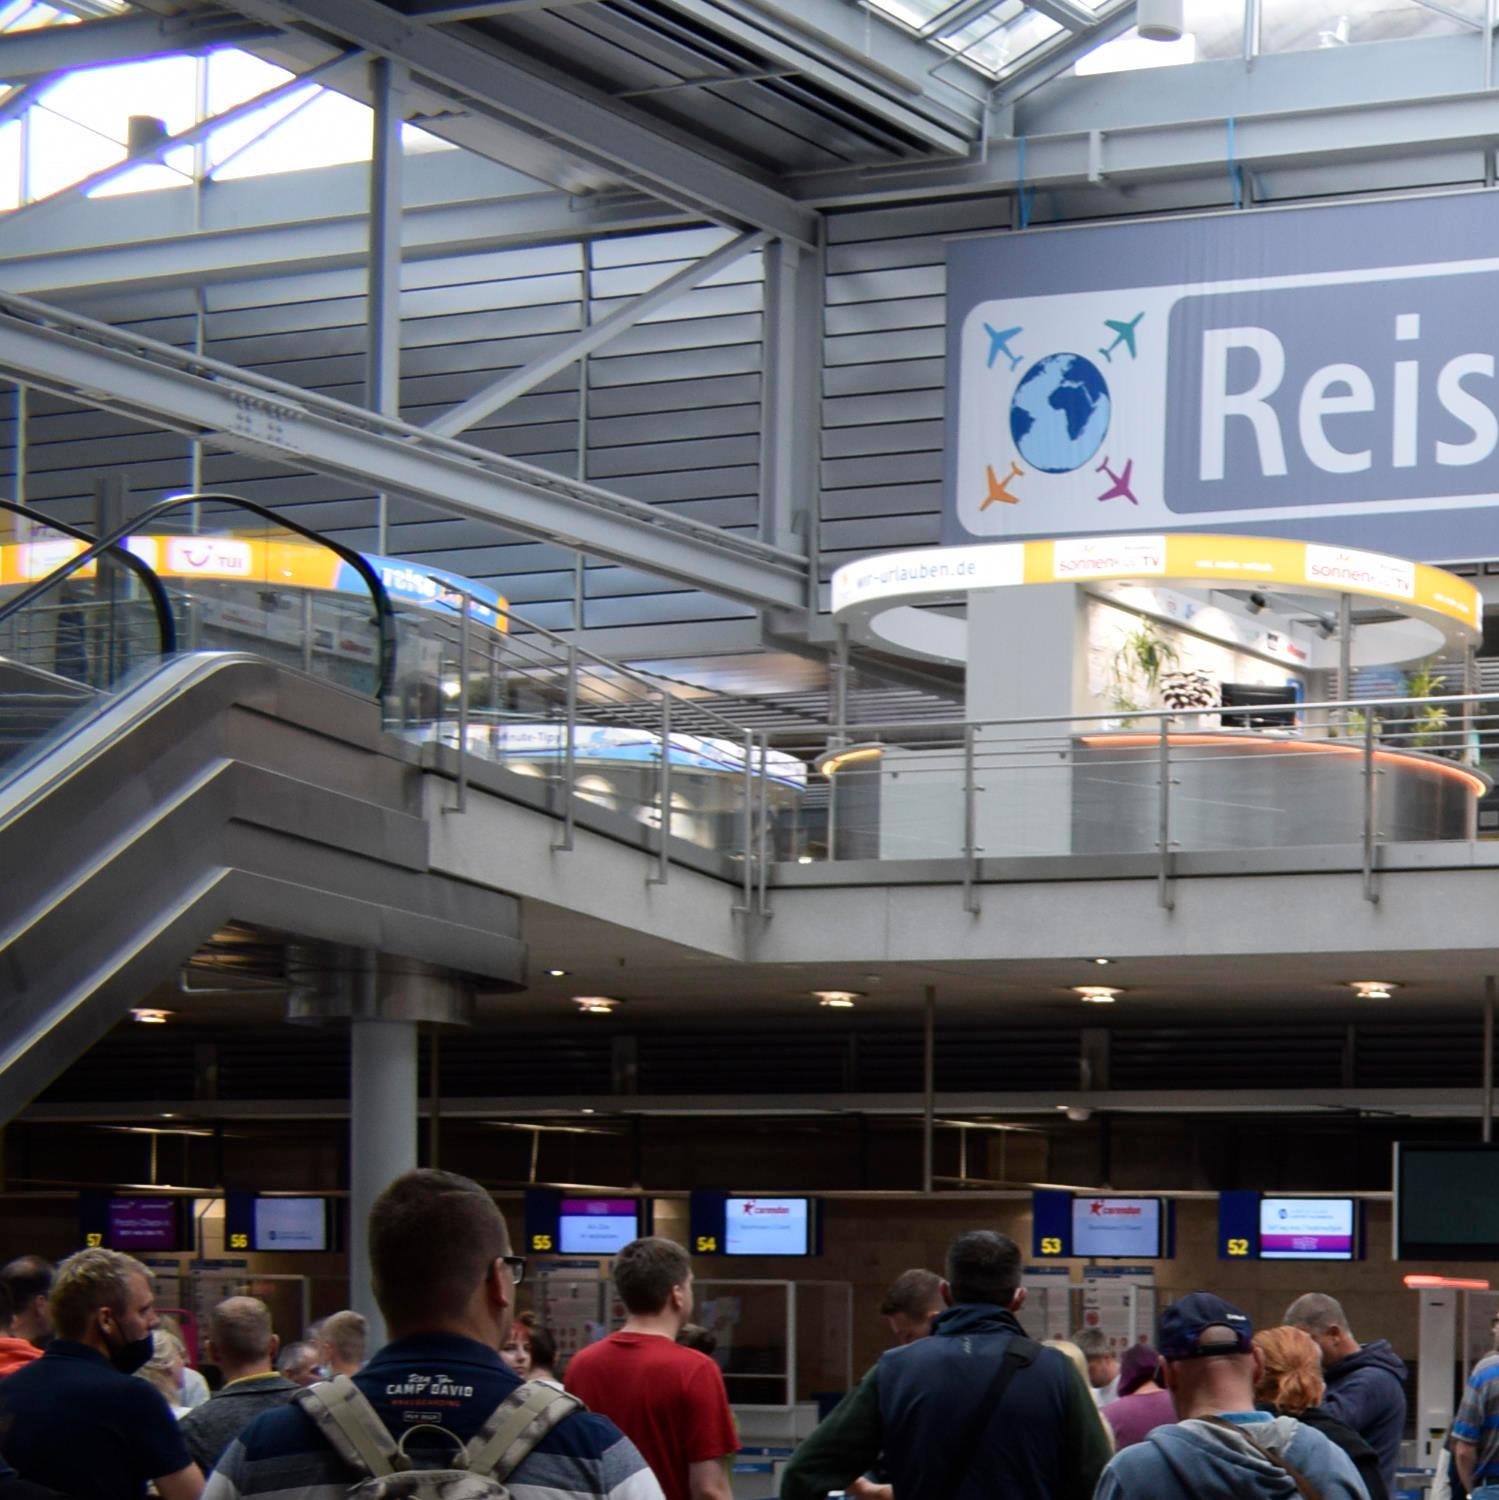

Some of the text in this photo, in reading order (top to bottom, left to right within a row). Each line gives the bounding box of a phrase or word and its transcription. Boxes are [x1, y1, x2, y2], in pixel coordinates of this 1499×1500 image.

[217, 556, 242, 568] TUI
[857, 560, 976, 589] wir-urlauben.de
[85, 1234, 103, 1247] 57
[231, 1234, 248, 1247] 56
[532, 1235, 551, 1249] 55
[697, 1237, 716, 1251] 54
[1041, 1239, 1062, 1253] 53
[1228, 1239, 1249, 1254] 52
[385, 1383, 427, 1396] CAMP
